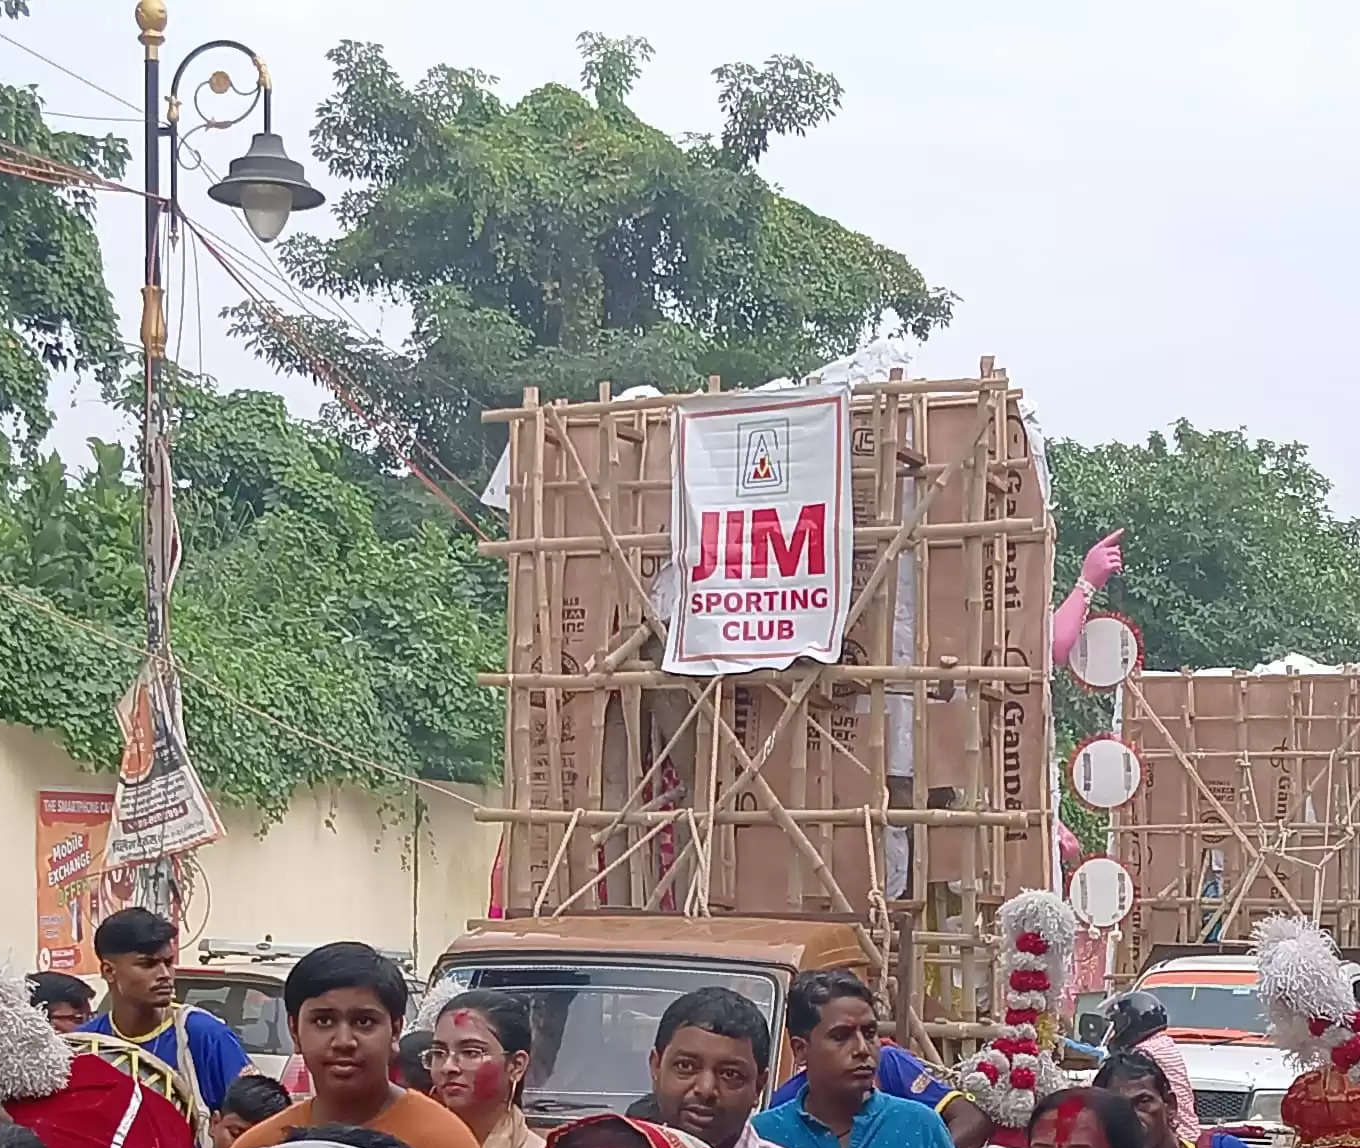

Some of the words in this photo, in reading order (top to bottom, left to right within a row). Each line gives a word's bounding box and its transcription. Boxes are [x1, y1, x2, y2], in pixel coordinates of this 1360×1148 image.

[692, 503, 826, 583] JIM
[691, 588, 828, 614] SPORTING
[722, 620, 795, 641] CLUB
[52, 833, 84, 863] Mobile
[48, 849, 92, 887] EXCHANGE
